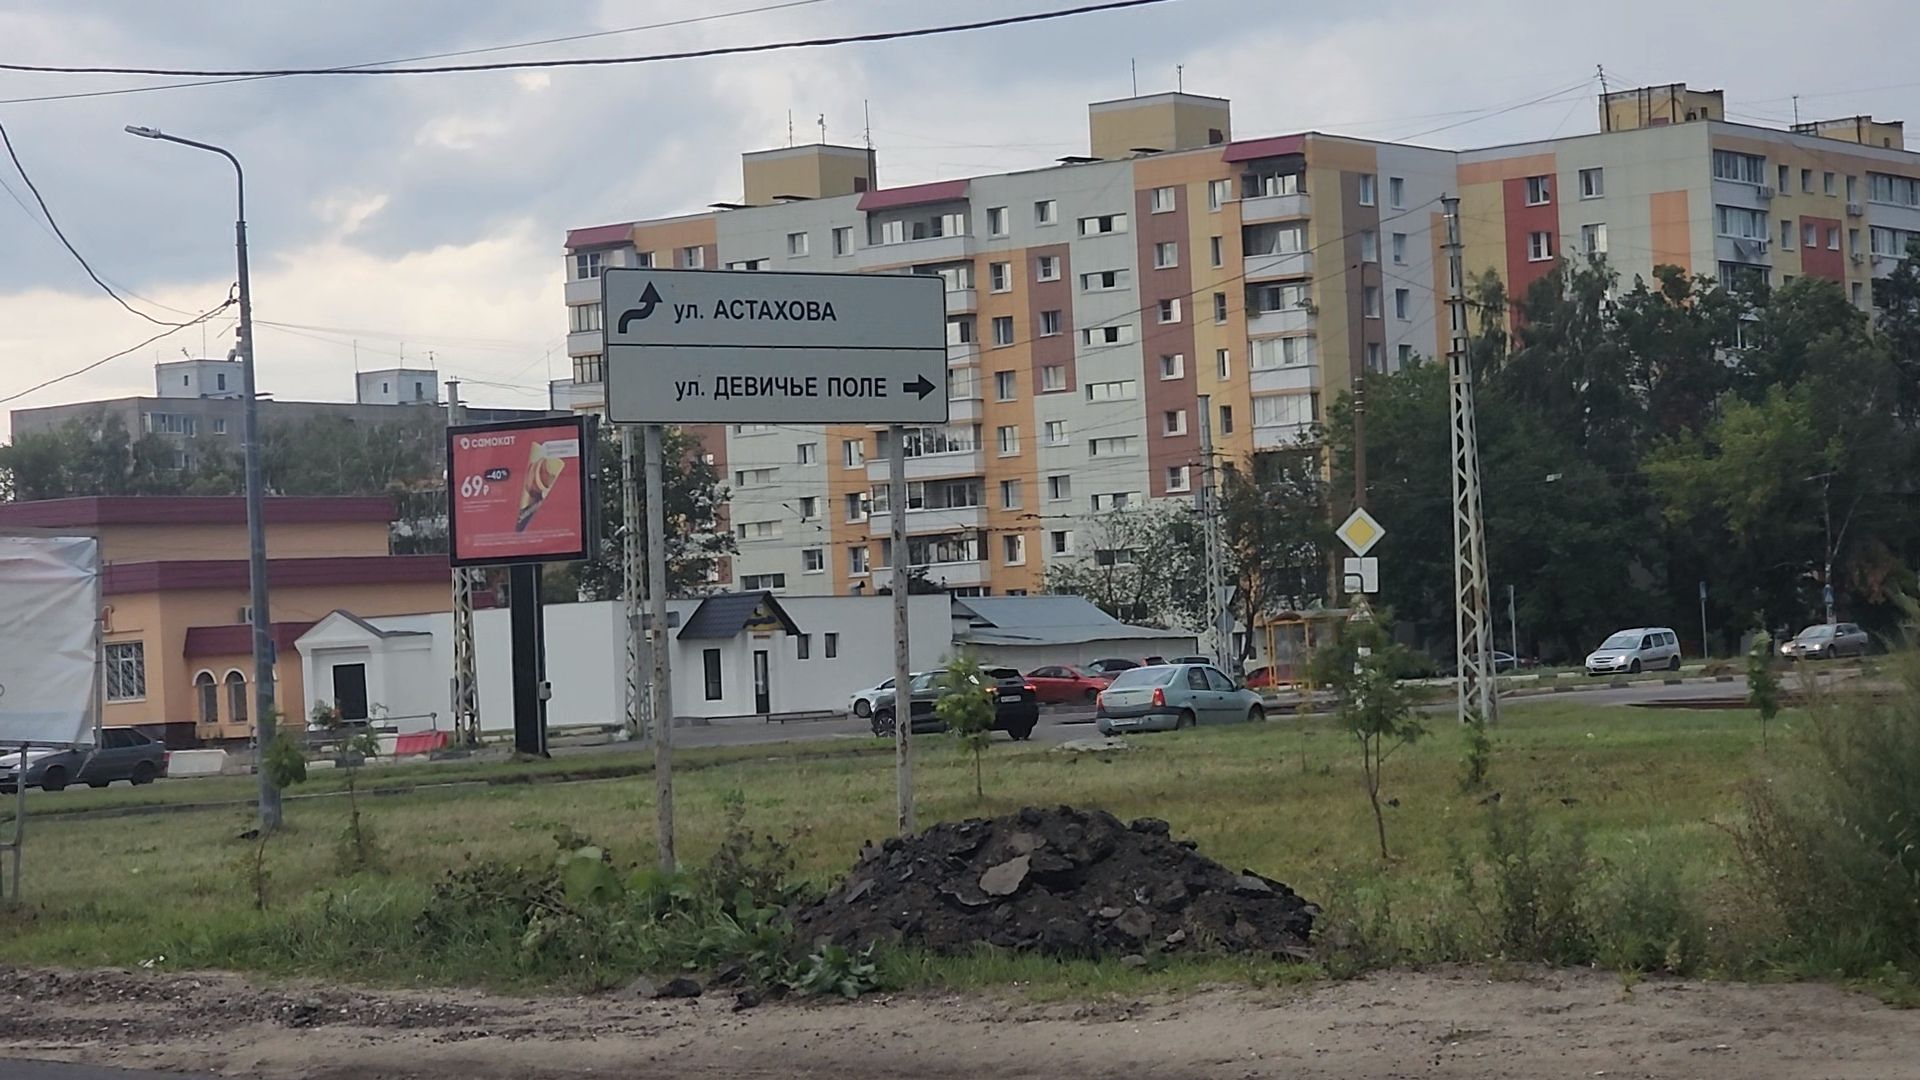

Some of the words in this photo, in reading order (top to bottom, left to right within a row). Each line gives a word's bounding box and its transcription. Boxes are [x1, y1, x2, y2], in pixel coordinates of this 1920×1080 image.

[674, 303, 704, 324] ул.
[713, 299, 837, 321] АСТАХОВА
[675, 380, 705, 401] ул.
[713, 376, 818, 400] ДЕВИЧЬЕ
[828, 377, 887, 397] ПОЛЕ
